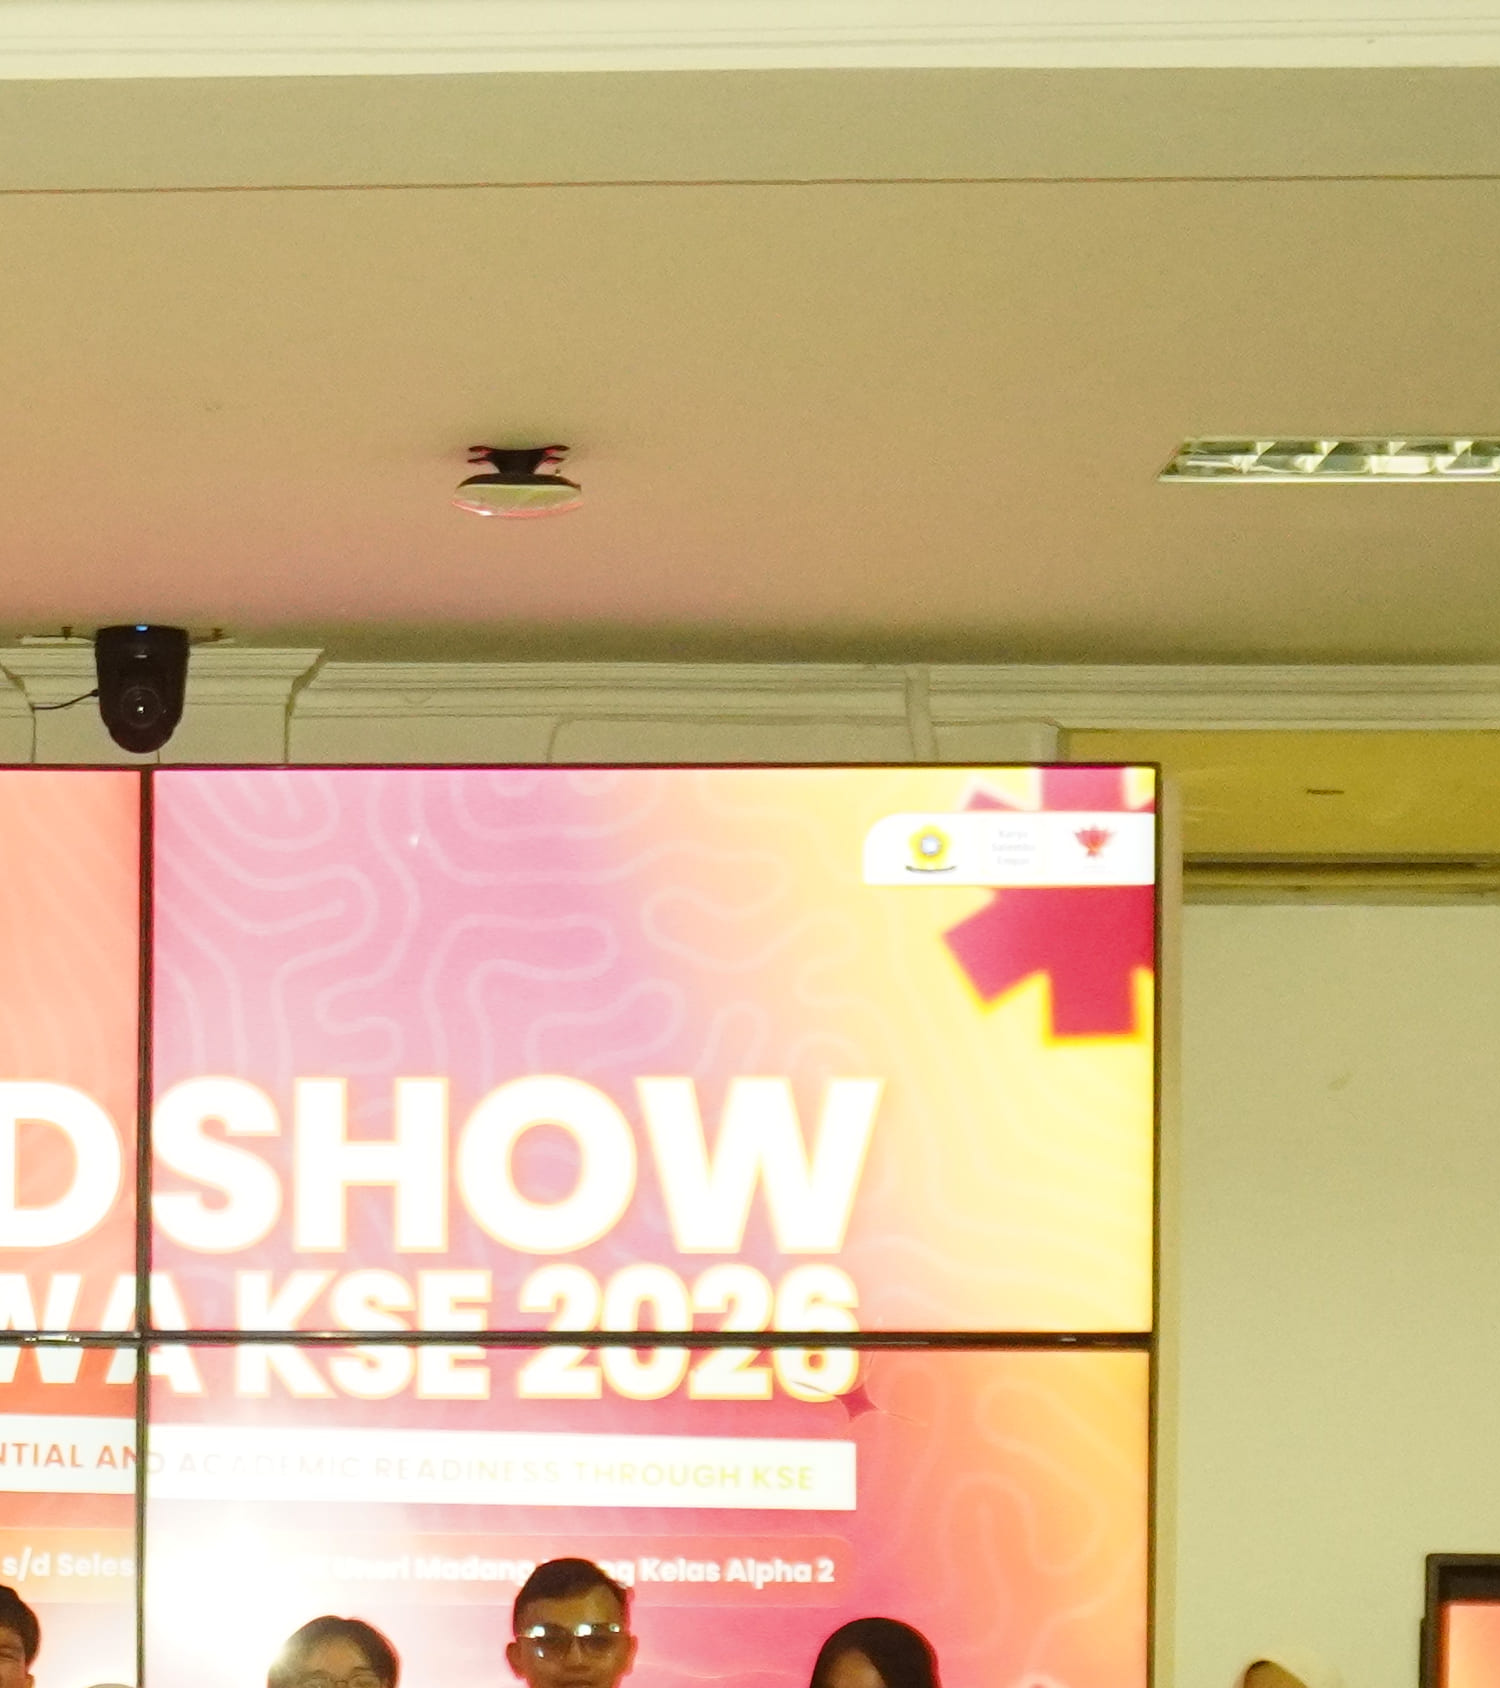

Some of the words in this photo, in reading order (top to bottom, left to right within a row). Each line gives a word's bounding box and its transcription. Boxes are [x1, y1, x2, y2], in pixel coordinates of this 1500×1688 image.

[235, 1269, 493, 1399] KSE
[517, 1263, 860, 1402] 2026
[374, 1457, 560, 1484] READINESS
[575, 1461, 742, 1489] THROUGH
[752, 1465, 816, 1491] KSE
[2, 1546, 50, 1582] s/d
[57, 1552, 136, 1578] Seles
[639, 1557, 721, 1583] Kelas
[726, 1557, 813, 1590] Alpha
[817, 1558, 836, 1583] 2
